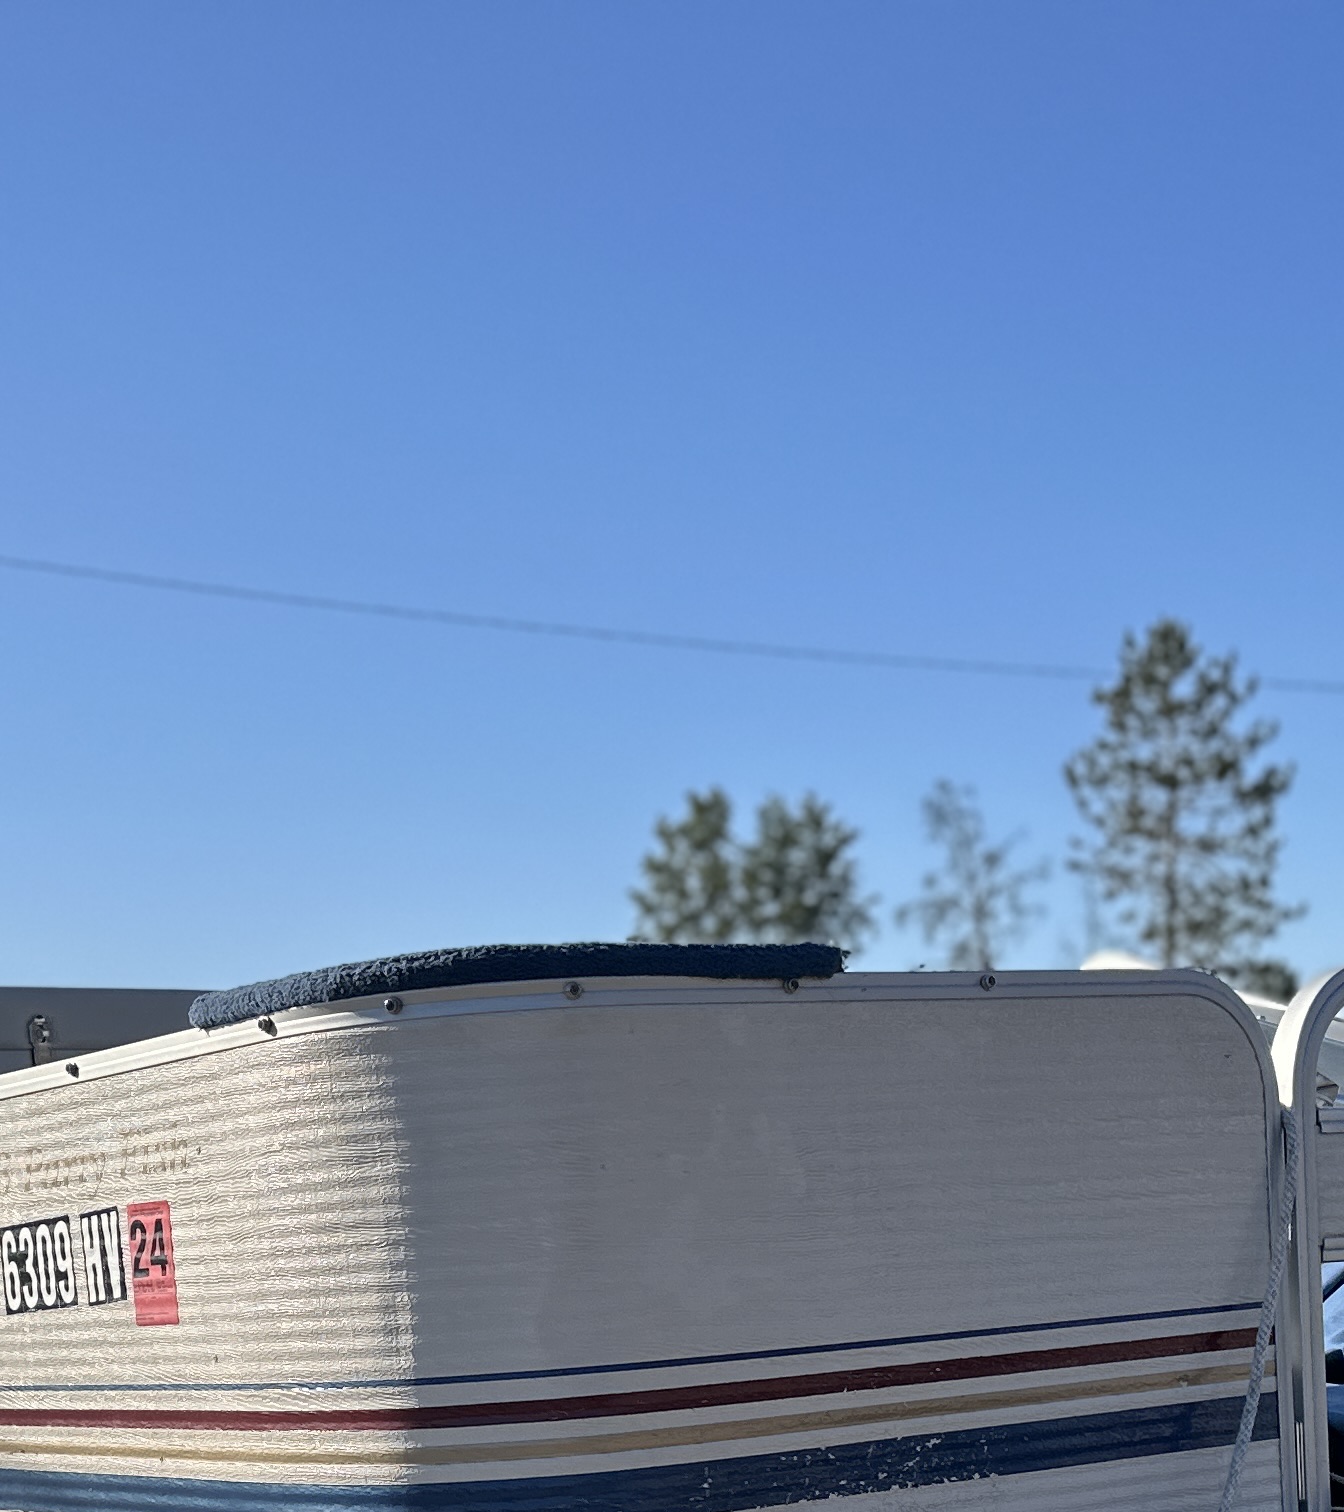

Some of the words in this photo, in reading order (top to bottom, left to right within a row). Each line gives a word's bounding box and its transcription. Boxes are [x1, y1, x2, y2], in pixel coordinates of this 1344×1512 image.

[2, 1220, 75, 1311] 6309
[81, 1210, 122, 1303] HV
[130, 1218, 168, 1278] 24
